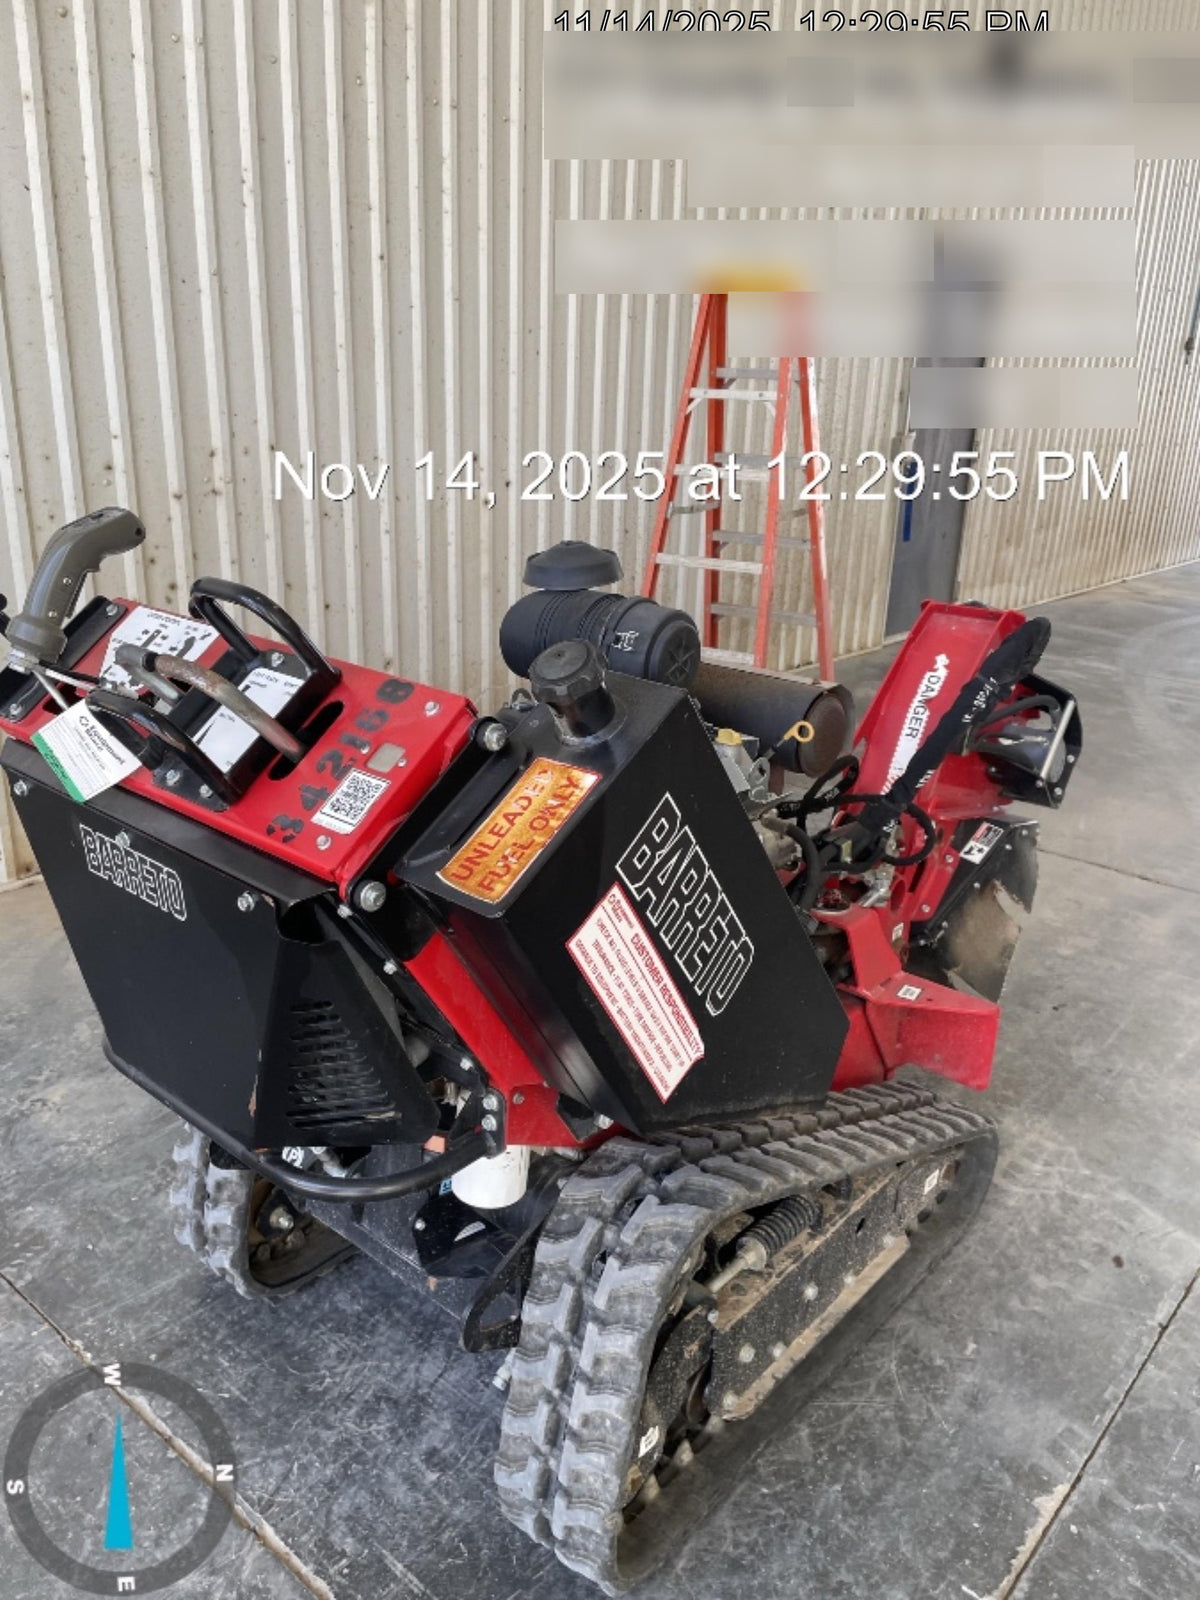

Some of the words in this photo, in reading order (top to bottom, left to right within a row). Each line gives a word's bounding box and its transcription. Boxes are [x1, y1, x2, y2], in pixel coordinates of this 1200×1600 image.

[905, 674, 941, 739] DANGER
[79, 823, 188, 922] BARRETO
[452, 767, 554, 883] UNLEADED
[479, 834, 535, 893] FUEL
[529, 775, 582, 832] ONLY
[614, 791, 755, 1017] BARRETO
[630, 932, 663, 986] CUSTOMER
[659, 982, 703, 1055] RESPONSIBILITY
